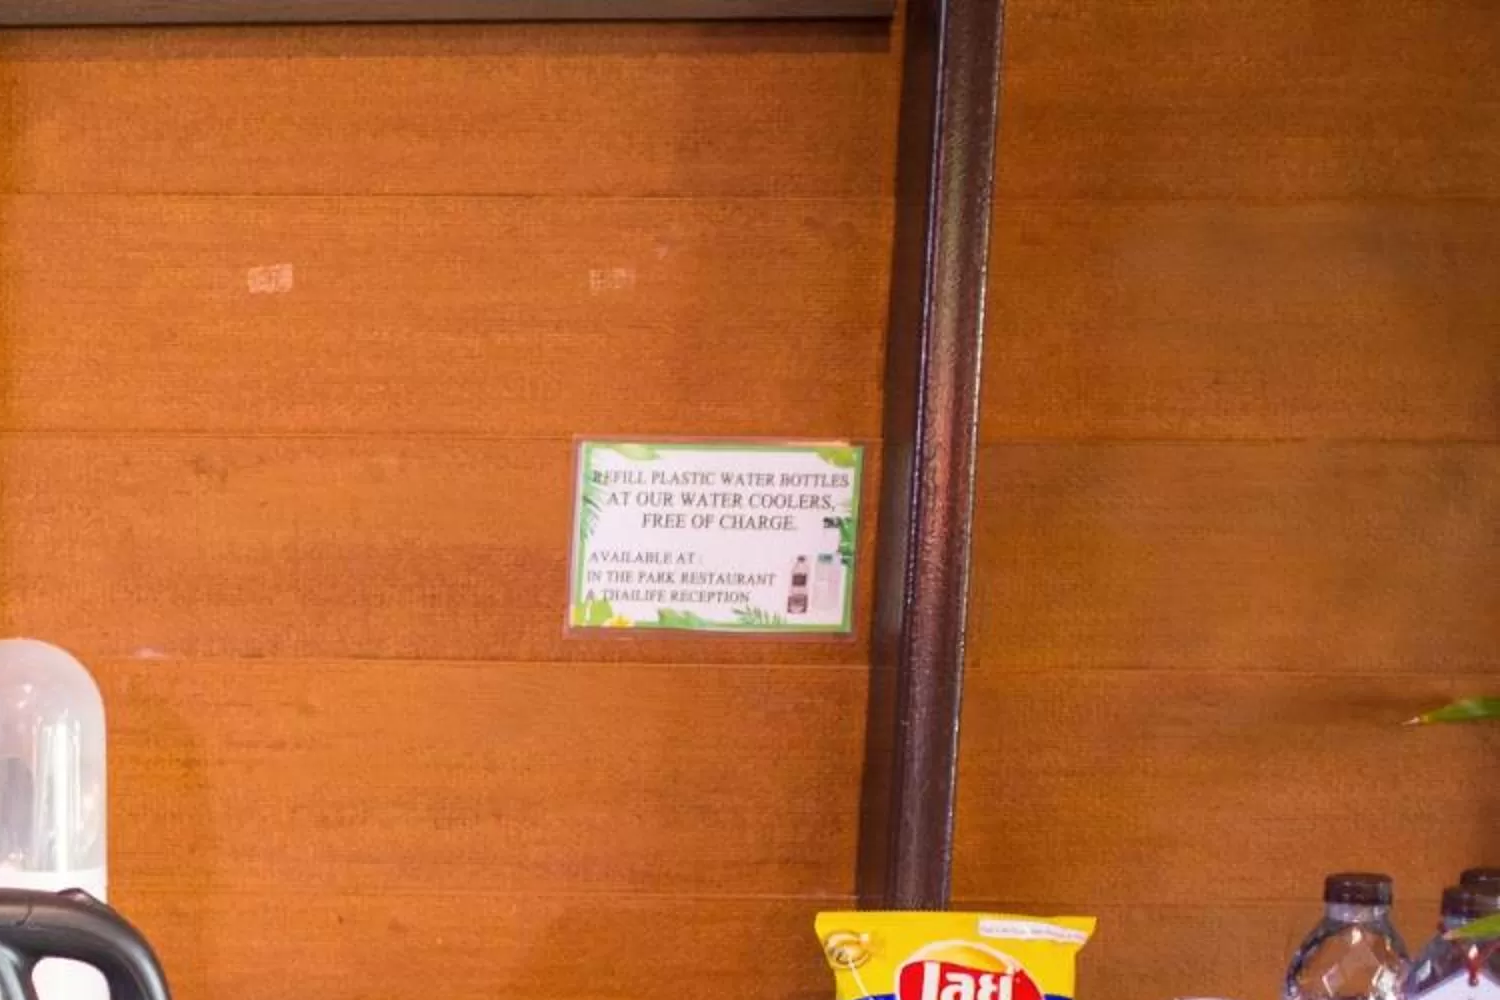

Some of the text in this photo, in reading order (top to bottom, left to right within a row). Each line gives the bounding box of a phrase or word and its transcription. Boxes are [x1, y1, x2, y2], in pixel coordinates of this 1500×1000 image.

[593, 470, 850, 488] REFILL PLASTIC WATER BOTTLES
[607, 491, 836, 511] AT OUR WATER COOLERS,
[642, 513, 687, 528] FREE
[691, 514, 715, 529] OF
[589, 551, 672, 564] AVAILABLE
[587, 570, 776, 586] IN THE PARK RESTAURANT
[670, 590, 751, 604] RECEPTION
